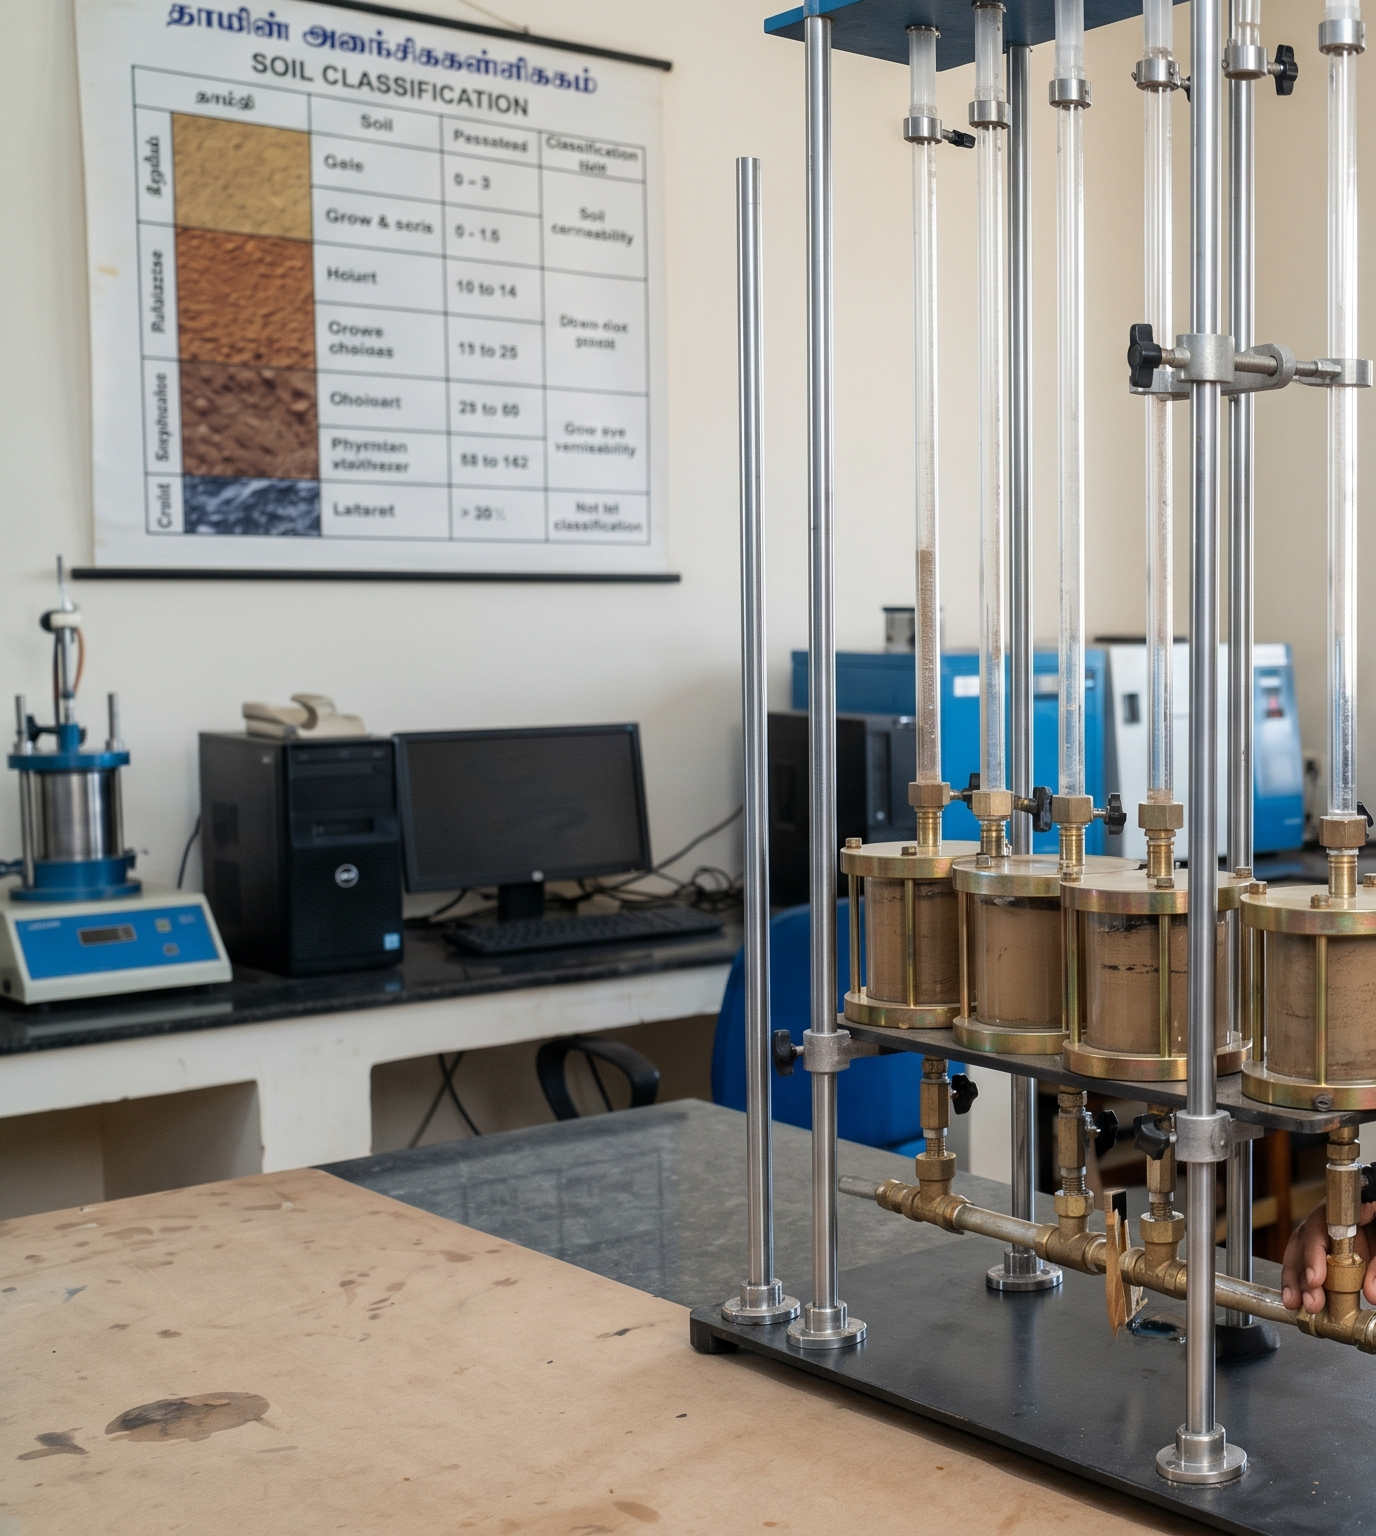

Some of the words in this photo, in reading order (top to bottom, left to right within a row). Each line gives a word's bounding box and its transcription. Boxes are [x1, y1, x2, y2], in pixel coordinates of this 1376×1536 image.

[252, 53, 315, 82] SOIL
[322, 64, 529, 117] CLASSIFICATION
[360, 113, 394, 132] Soil
[453, 171, 464, 187] 0
[481, 175, 491, 190] 3
[377, 214, 390, 229] &
[455, 223, 465, 239] 0
[457, 279, 475, 295] 10
[479, 281, 496, 297] to
[500, 283, 518, 299] 14
[480, 343, 496, 359] to
[482, 402, 497, 417] to
[483, 453, 498, 469] to
